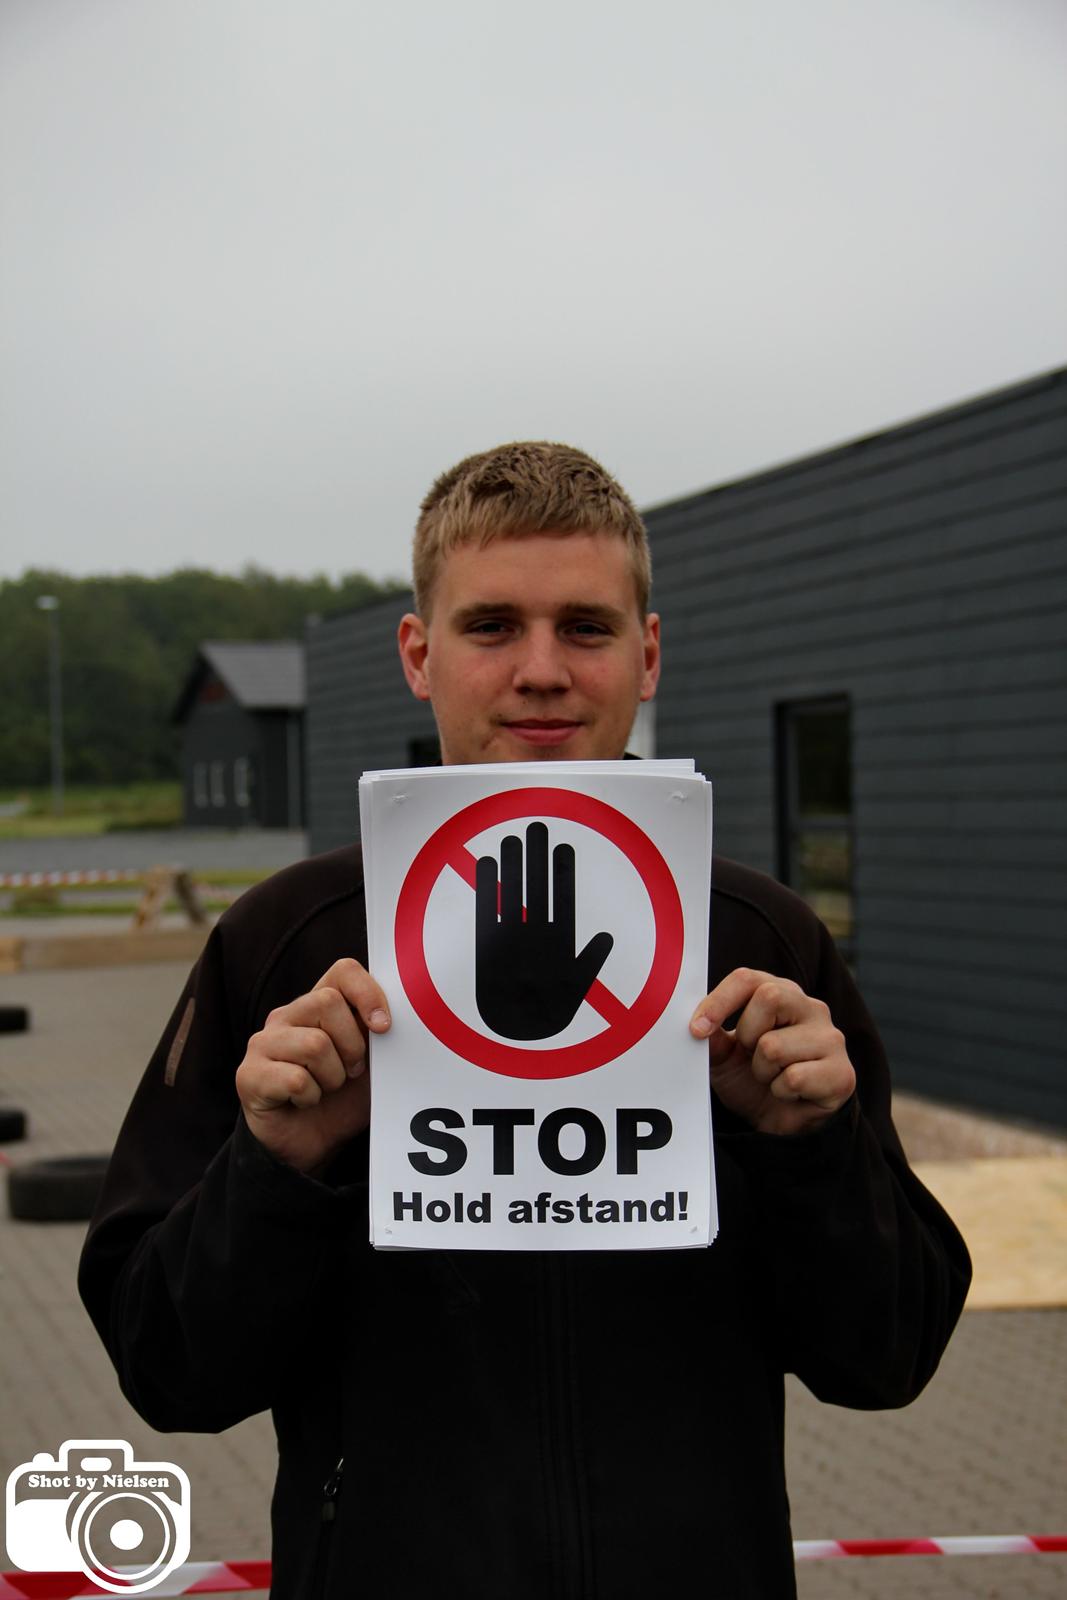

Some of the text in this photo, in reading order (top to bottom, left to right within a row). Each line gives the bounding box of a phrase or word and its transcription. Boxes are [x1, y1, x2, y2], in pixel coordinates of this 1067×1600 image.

[407, 1107, 673, 1177] STOP
[392, 1191, 689, 1224] Hold afstand!
